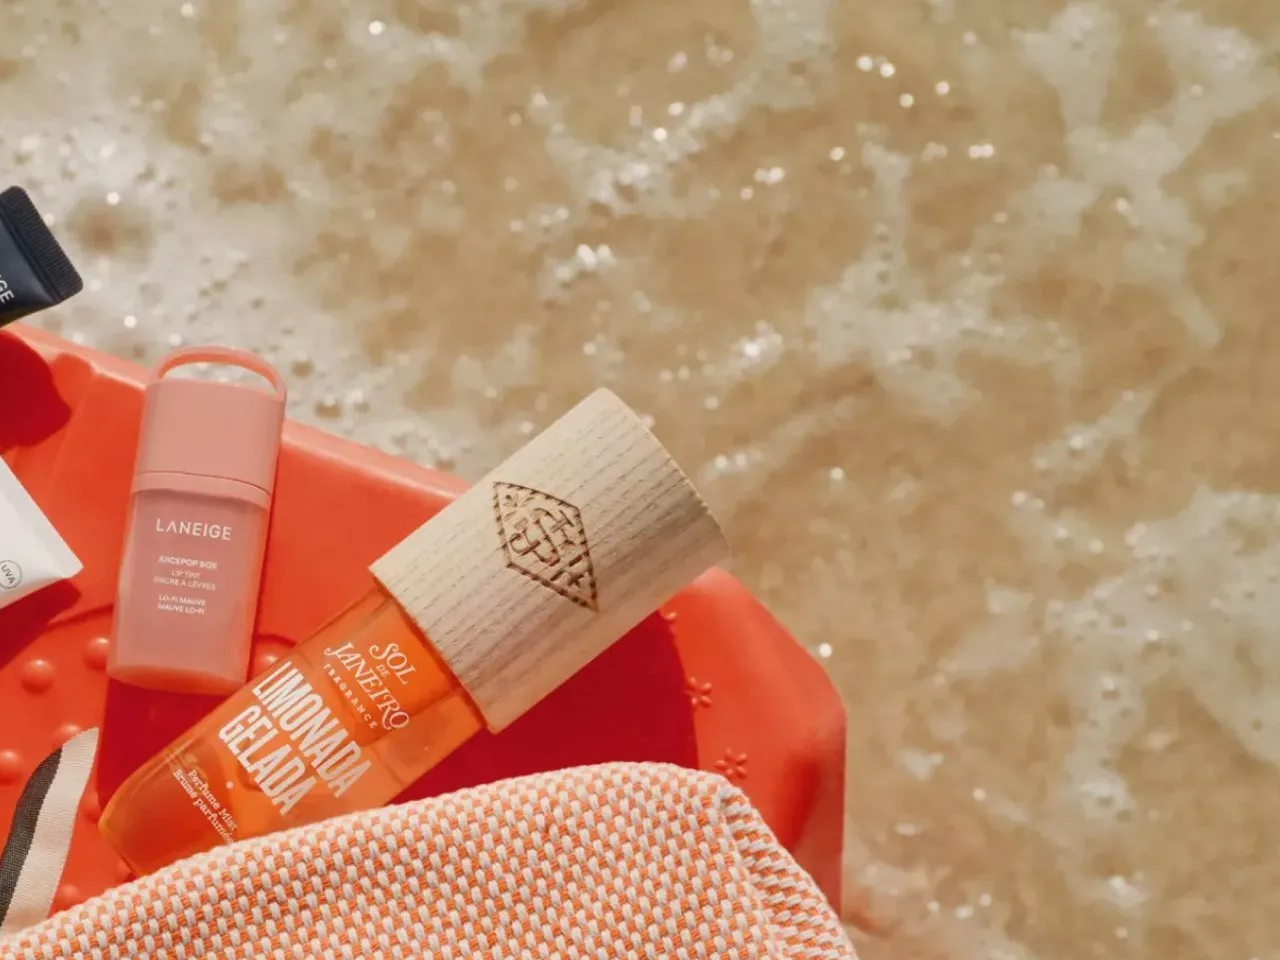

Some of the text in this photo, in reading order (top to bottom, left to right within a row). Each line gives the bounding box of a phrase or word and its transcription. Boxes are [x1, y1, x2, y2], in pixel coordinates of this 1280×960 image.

[156, 518, 232, 540] LANEIGE
[1, 564, 16, 584] UVA
[324, 642, 410, 731] JANEIRO
[369, 642, 417, 684] SOL
[376, 664, 390, 678] DE
[323, 663, 378, 729] FRAGRANCE
[252, 661, 372, 799] LIMONADA
[174, 769, 198, 800] Brume
[218, 705, 317, 816] GELADA
[188, 769, 238, 832] Perfume Mist
